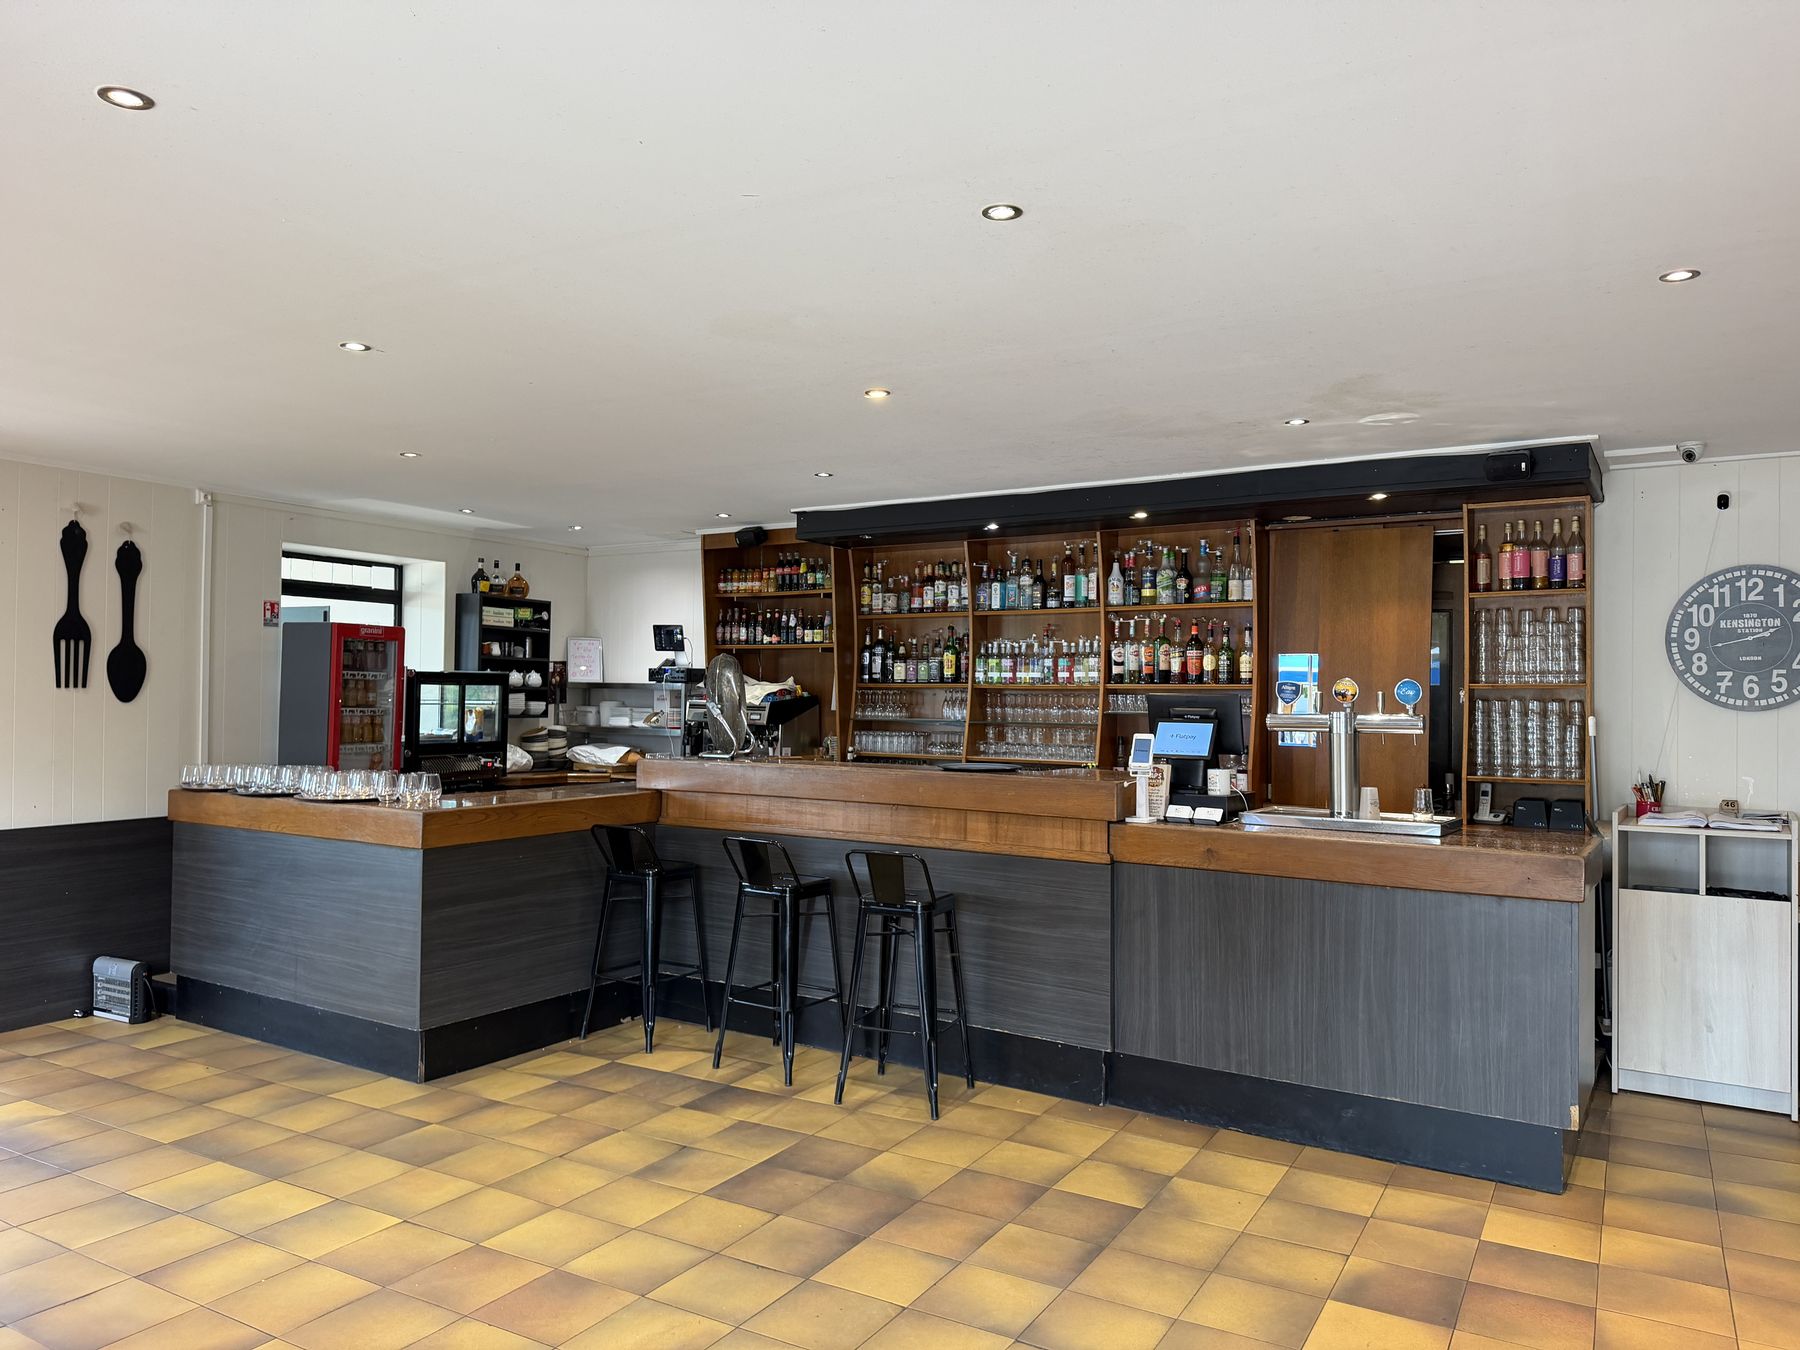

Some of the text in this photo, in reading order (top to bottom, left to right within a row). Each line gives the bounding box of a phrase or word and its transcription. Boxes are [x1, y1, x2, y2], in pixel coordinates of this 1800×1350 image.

[1708, 584, 1731, 608] 11
[1736, 578, 1764, 601] 12
[1773, 583, 1785, 608] 1
[1688, 603, 1715, 627] 10
[1719, 618, 1781, 628] KENSINGTON
[1683, 627, 1700, 651] 9
[1691, 652, 1708, 676] 8
[1716, 671, 1734, 694] 7
[1742, 675, 1760, 699] 6
[1770, 669, 1788, 693] 5
[1175, 733, 1197, 741] Flatpay
